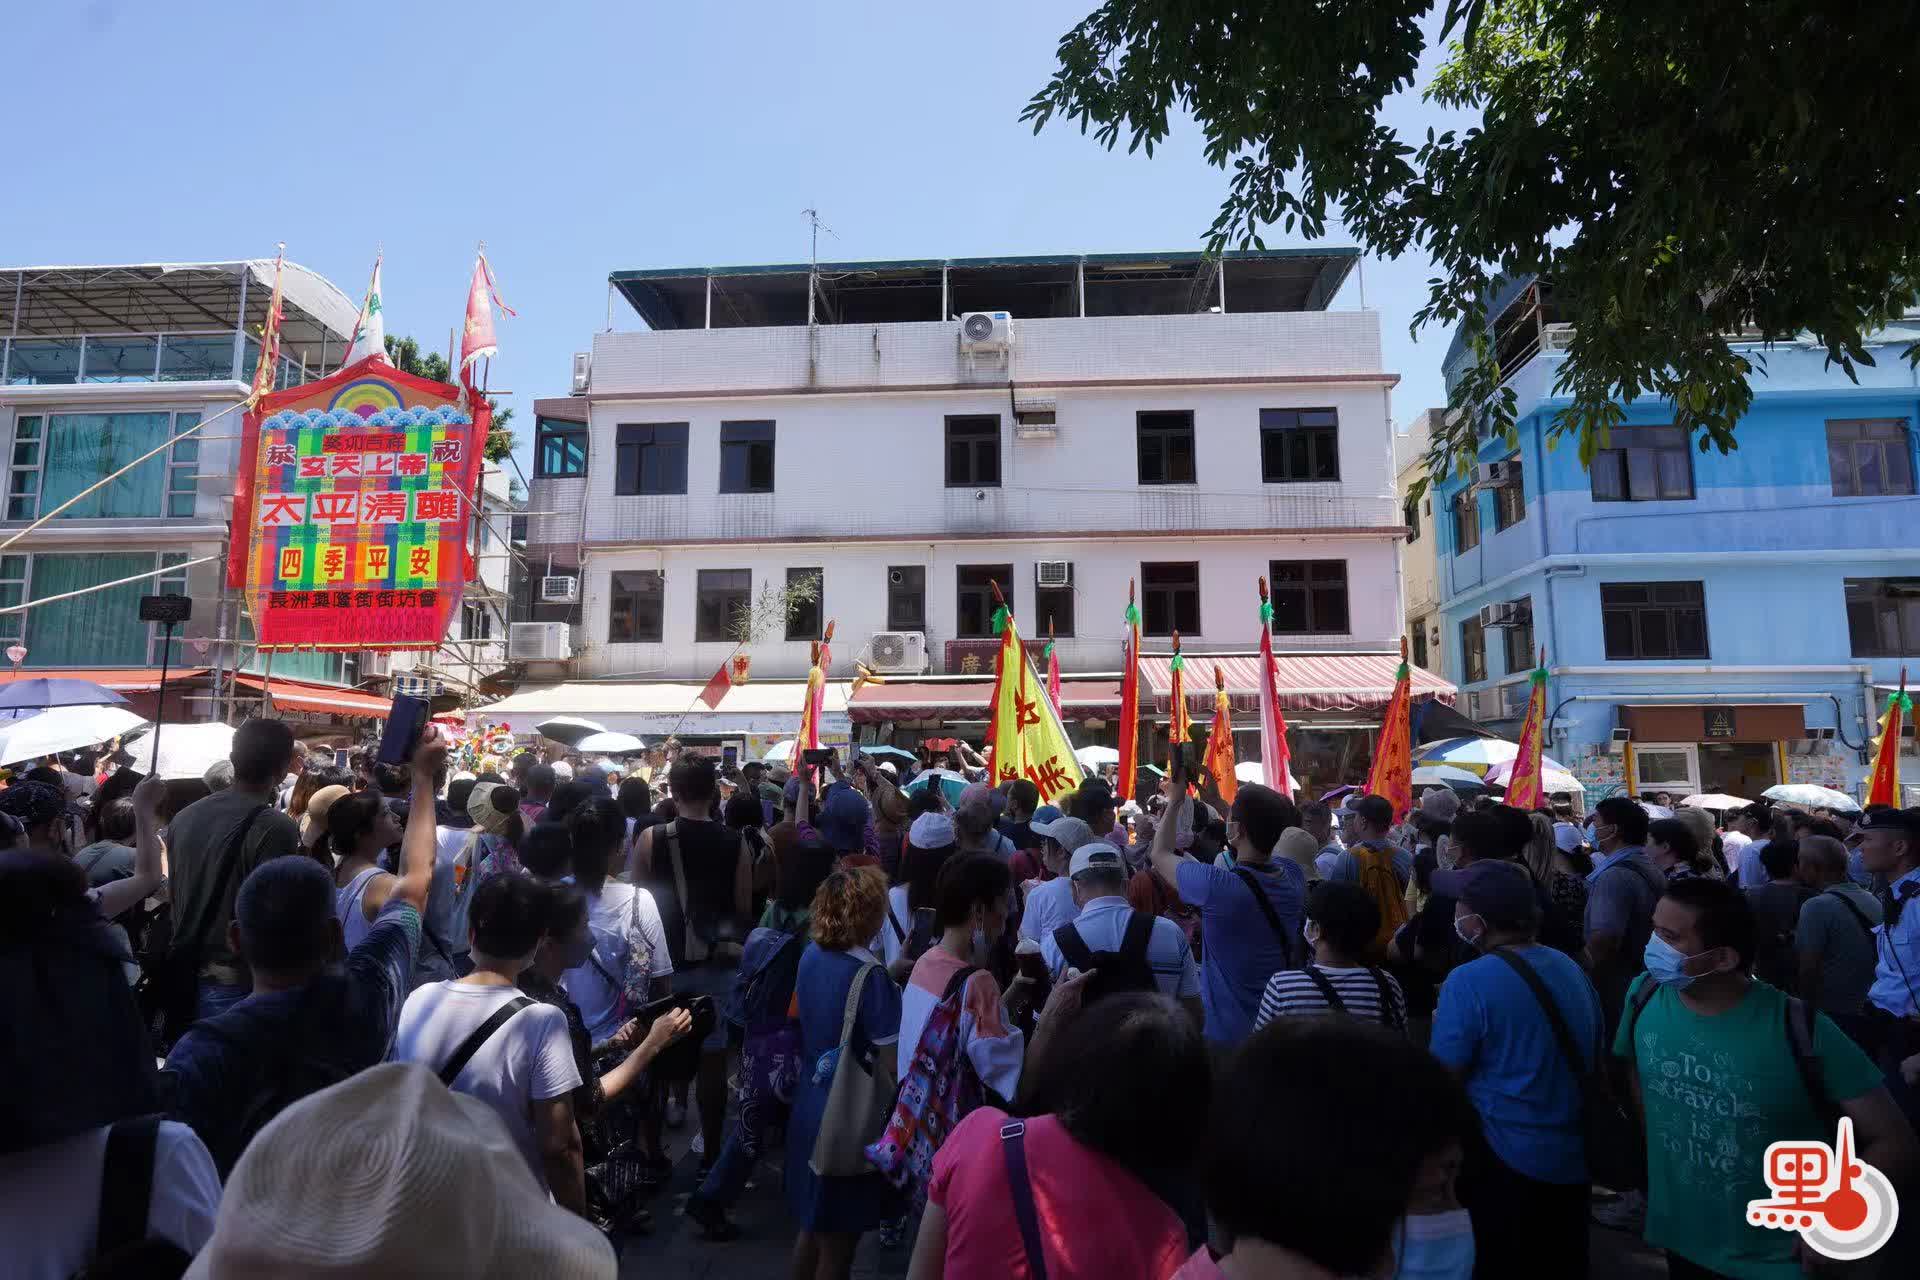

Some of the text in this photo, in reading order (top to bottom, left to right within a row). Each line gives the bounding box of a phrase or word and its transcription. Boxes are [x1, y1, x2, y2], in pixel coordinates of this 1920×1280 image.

[433, 440, 461, 462] 祝
[300, 453, 427, 478] 玄天上帝
[262, 491, 458, 523] 太平清醮
[281, 547, 431, 578] 四季平安
[269, 590, 438, 609] 長洲興隆街街坊會
[1680, 1051, 1712, 1083] To
